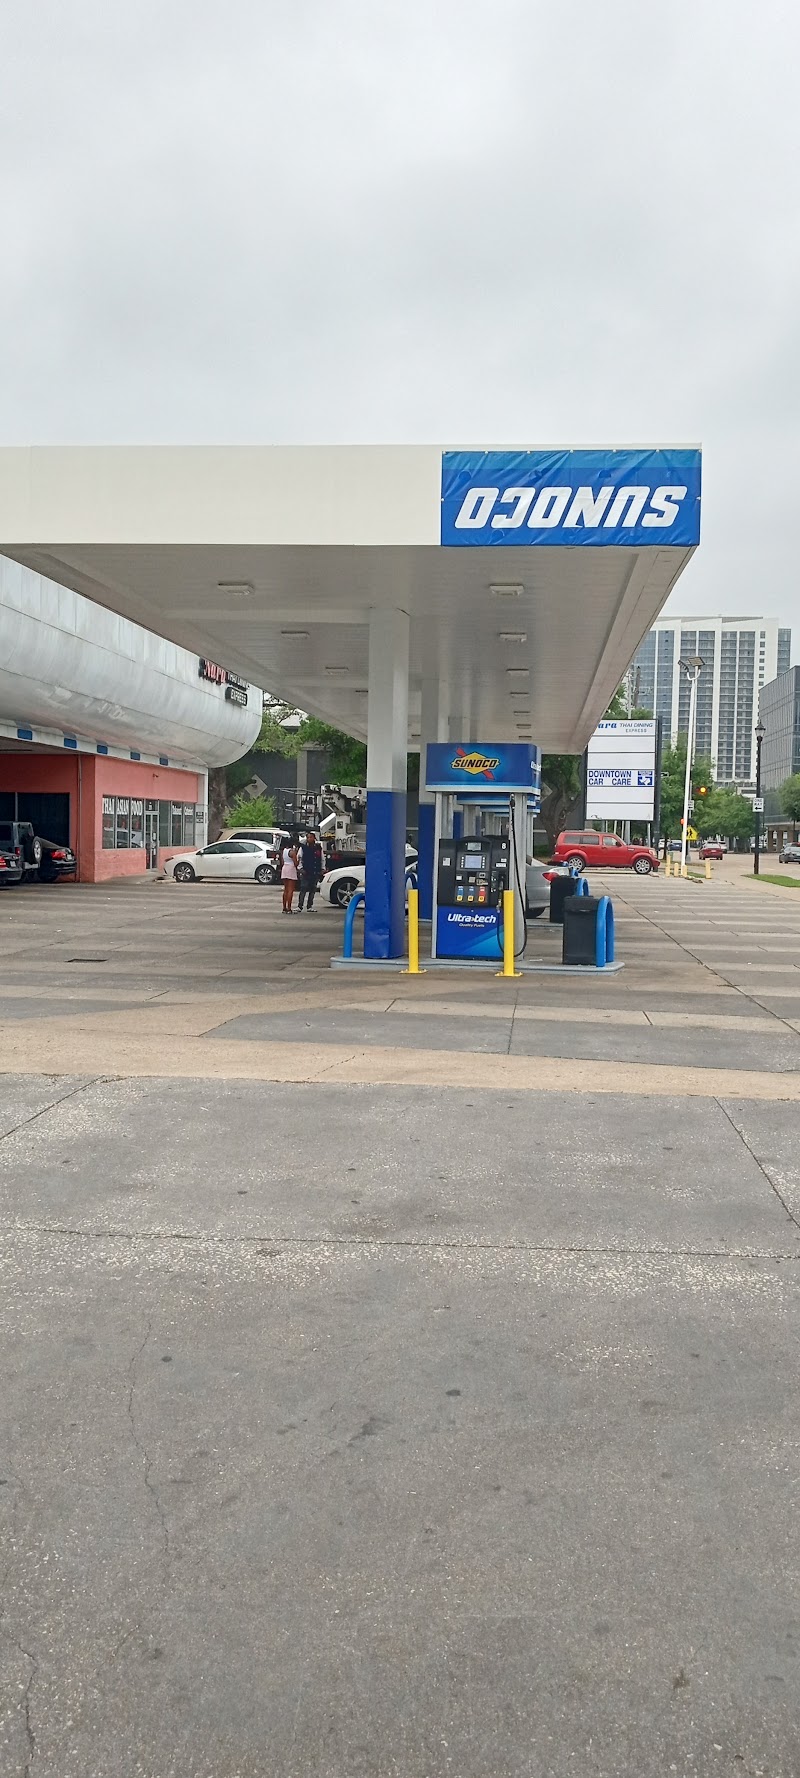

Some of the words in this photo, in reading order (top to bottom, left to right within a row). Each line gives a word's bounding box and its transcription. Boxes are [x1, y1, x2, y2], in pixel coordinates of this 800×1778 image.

[454, 486, 688, 529] SUNOCO
[231, 689, 246, 705] EXPRESS
[453, 759, 498, 768] SUNOCO
[588, 770, 632, 778] DOWNTOWN
[588, 778, 604, 786] CAR
[611, 778, 632, 786] CARE
[102, 798, 115, 814] THAI
[116, 799, 130, 815] ASIAN
[130, 800, 143, 816] FOOD
